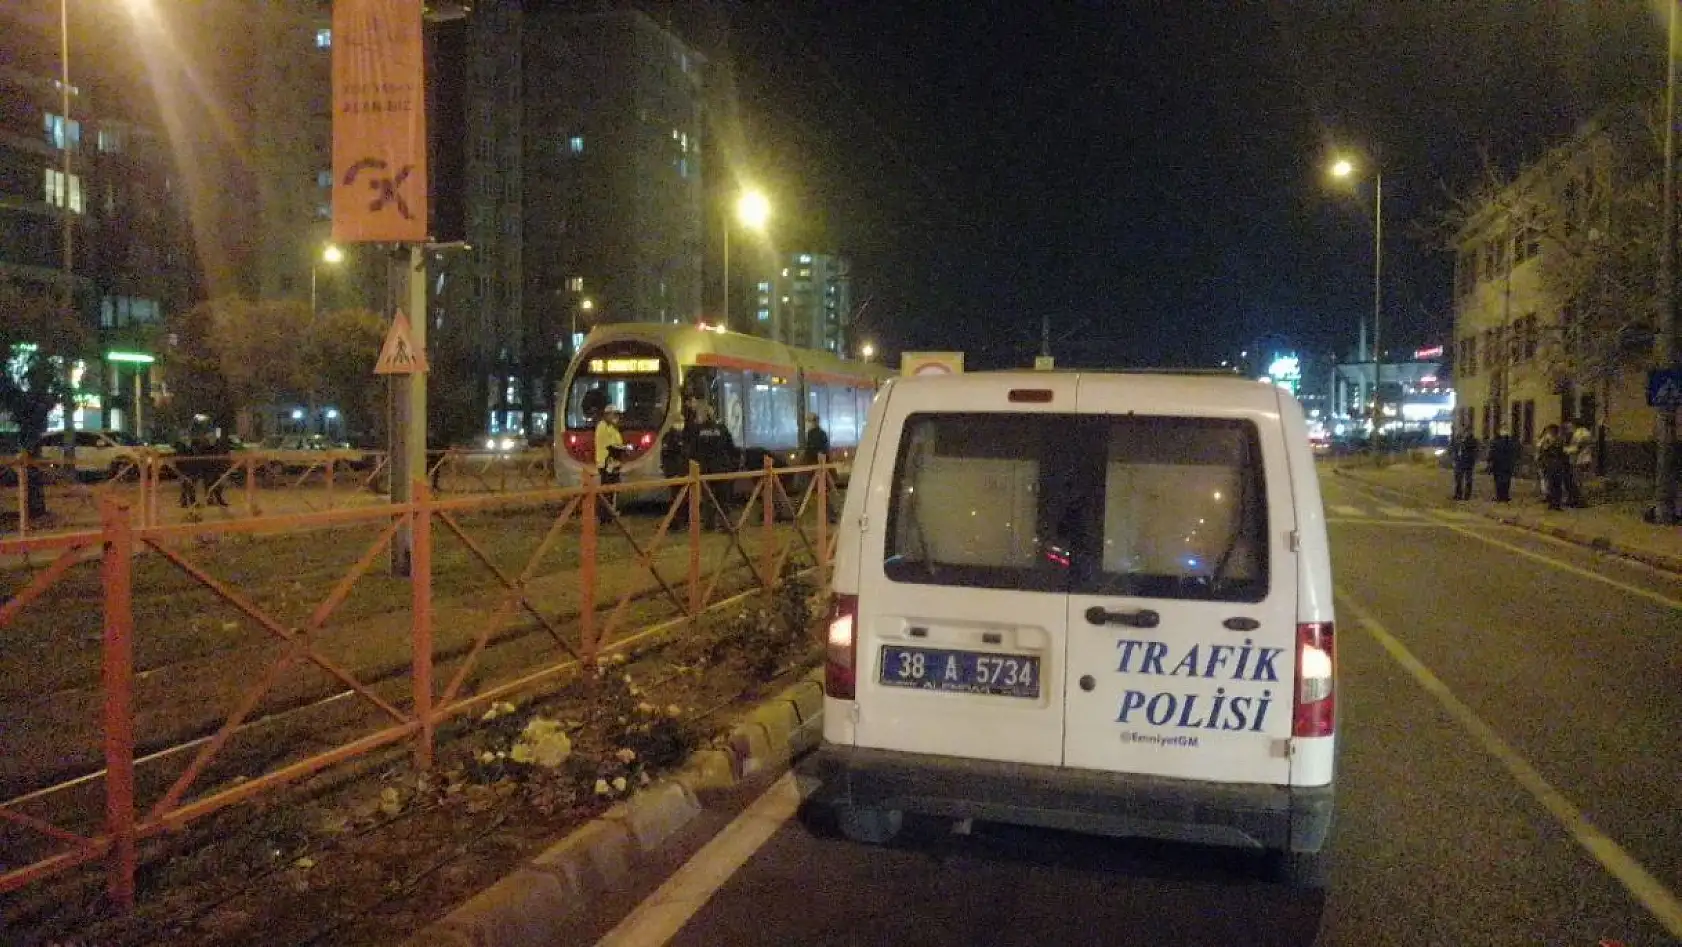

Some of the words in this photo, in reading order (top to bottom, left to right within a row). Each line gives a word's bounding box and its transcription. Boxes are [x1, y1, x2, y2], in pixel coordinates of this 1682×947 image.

[898, 652, 925, 679] 38
[945, 655, 958, 681] A
[976, 657, 1032, 686] 5734
[1116, 638, 1286, 682] TRAFİK
[1114, 687, 1273, 732] POLİSİ
